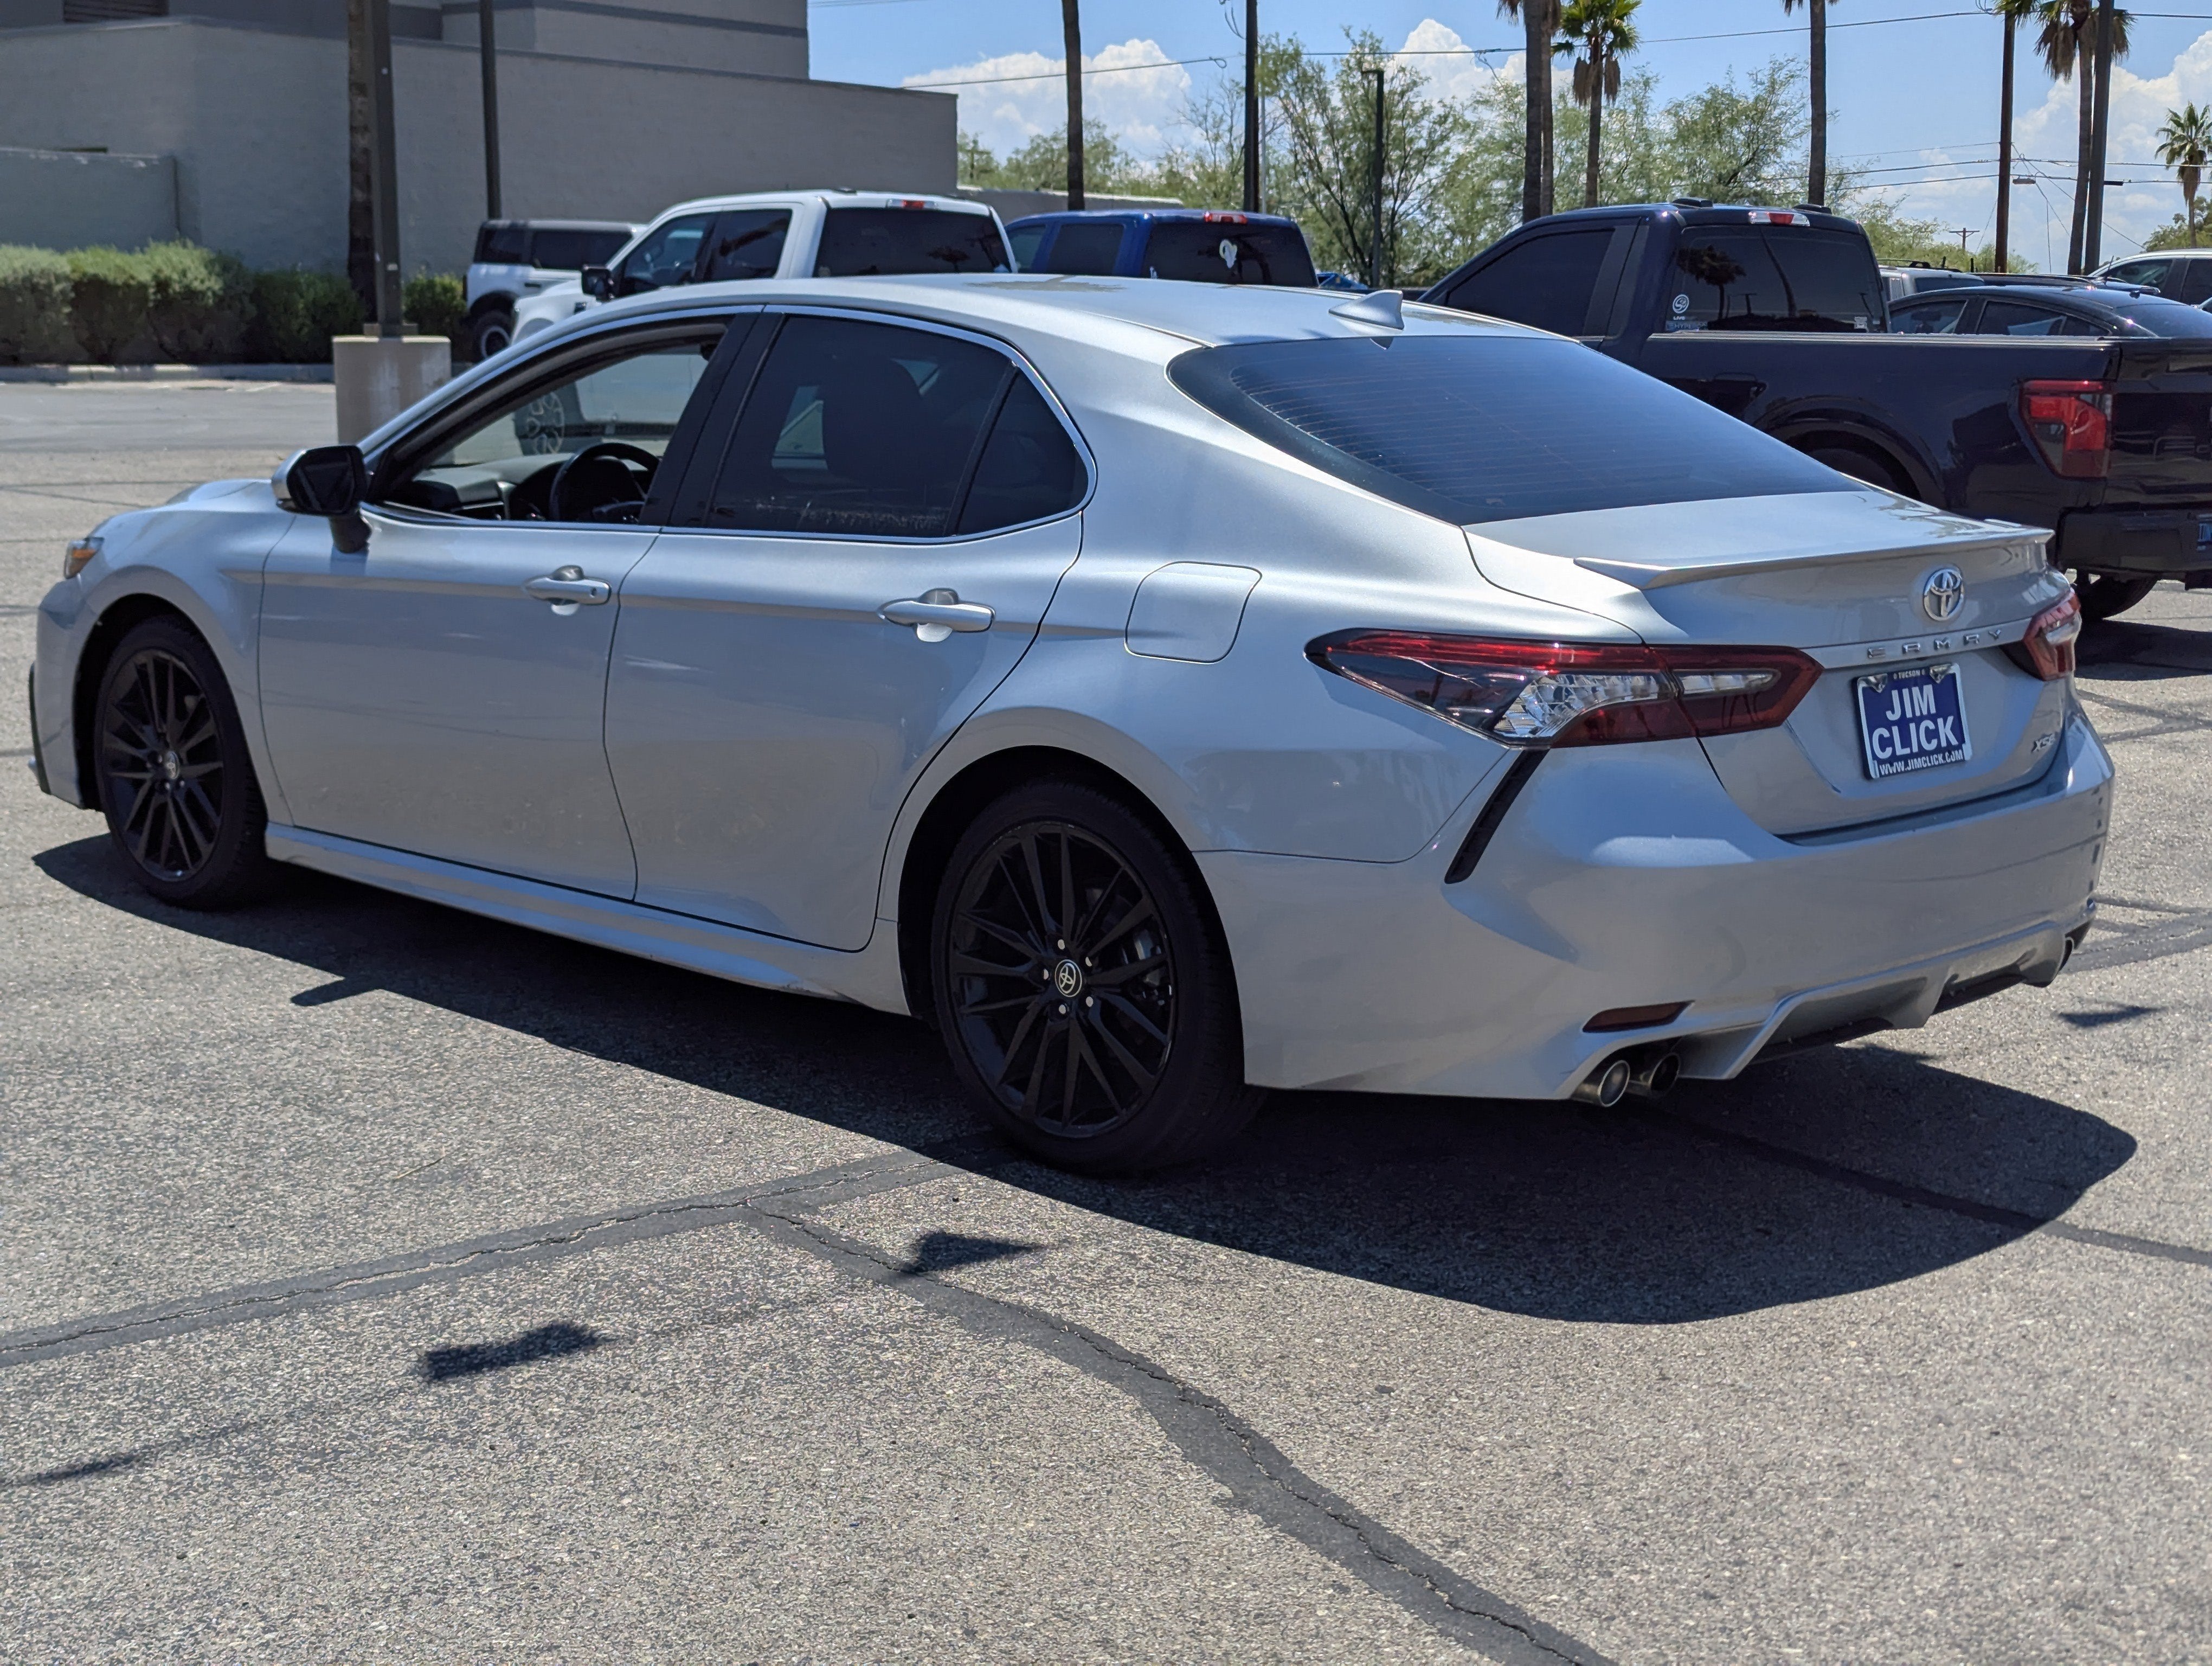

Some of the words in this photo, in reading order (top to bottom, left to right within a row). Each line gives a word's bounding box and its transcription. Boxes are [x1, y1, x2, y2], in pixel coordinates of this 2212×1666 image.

[1868, 629, 2001, 658] CAMRY
[1898, 669, 1920, 679] TUCSON
[1886, 684, 1936, 721] JIM
[1872, 716, 1959, 759] CLICK
[1879, 749, 1963, 776] WWW.JIMCLICK.COM
